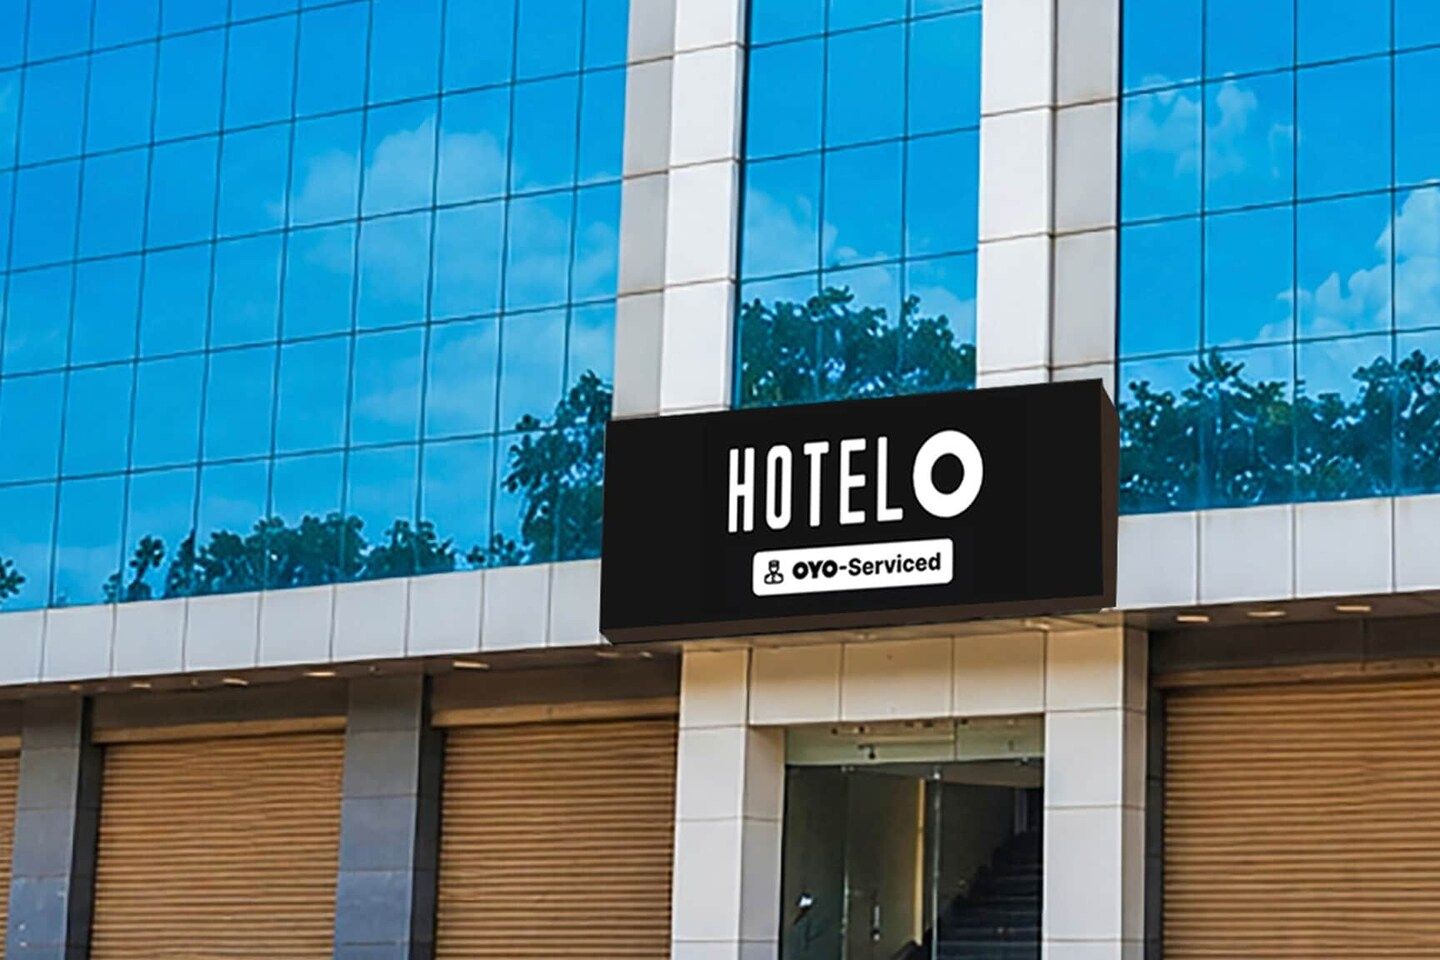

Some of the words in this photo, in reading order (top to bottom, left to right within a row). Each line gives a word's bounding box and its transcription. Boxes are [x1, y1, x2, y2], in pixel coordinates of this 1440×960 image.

[728, 436, 904, 533] HOTEL
[912, 430, 984, 518] O
[792, 552, 941, 580] OYO-Serviced
